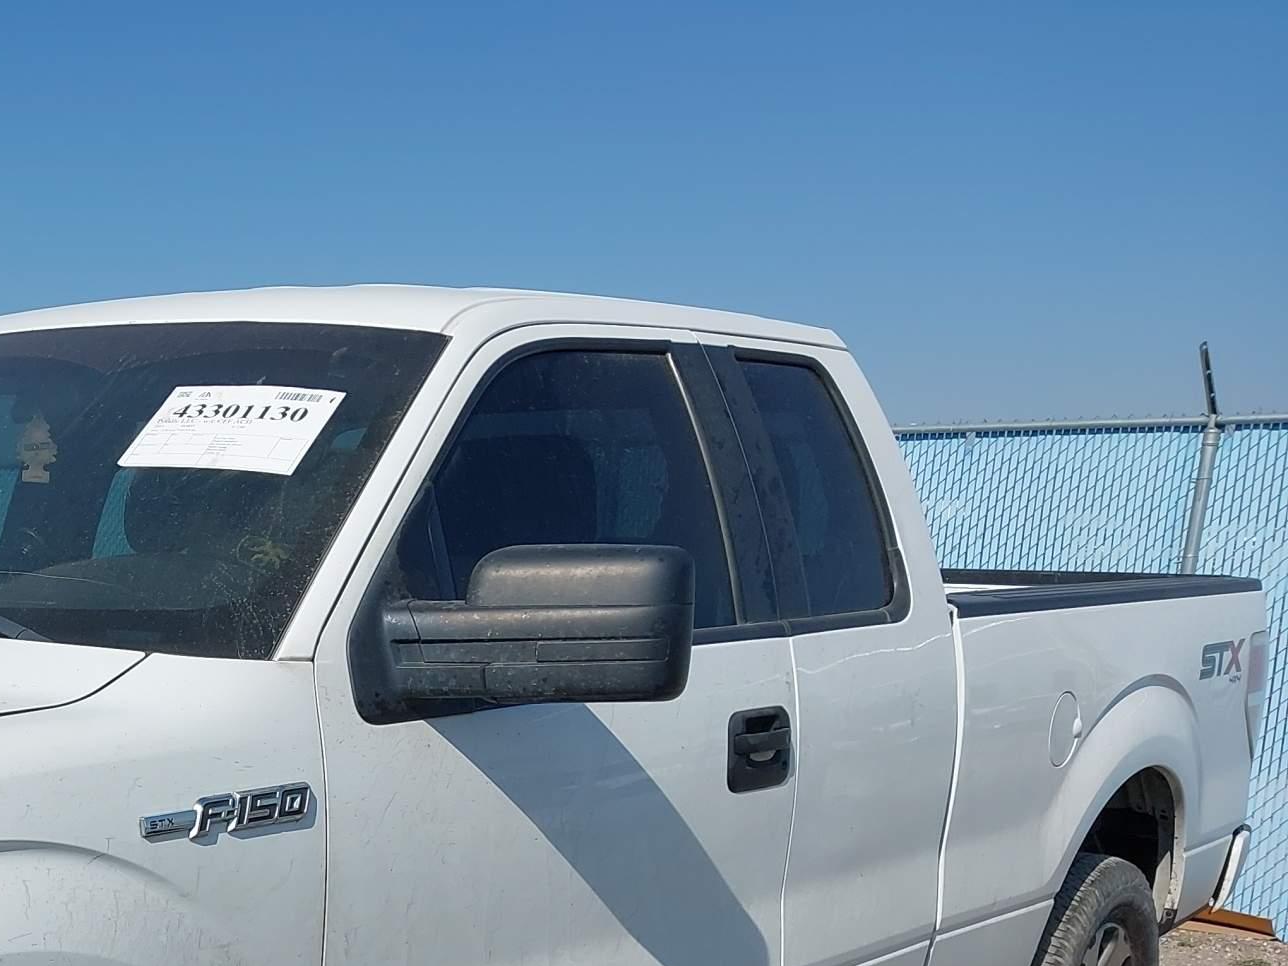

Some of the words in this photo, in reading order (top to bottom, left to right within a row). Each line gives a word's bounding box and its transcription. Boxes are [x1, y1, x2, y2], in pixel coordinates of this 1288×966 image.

[172, 403, 309, 423] 43301130
[1198, 638, 1246, 680] STX
[149, 816, 175, 831] STX
